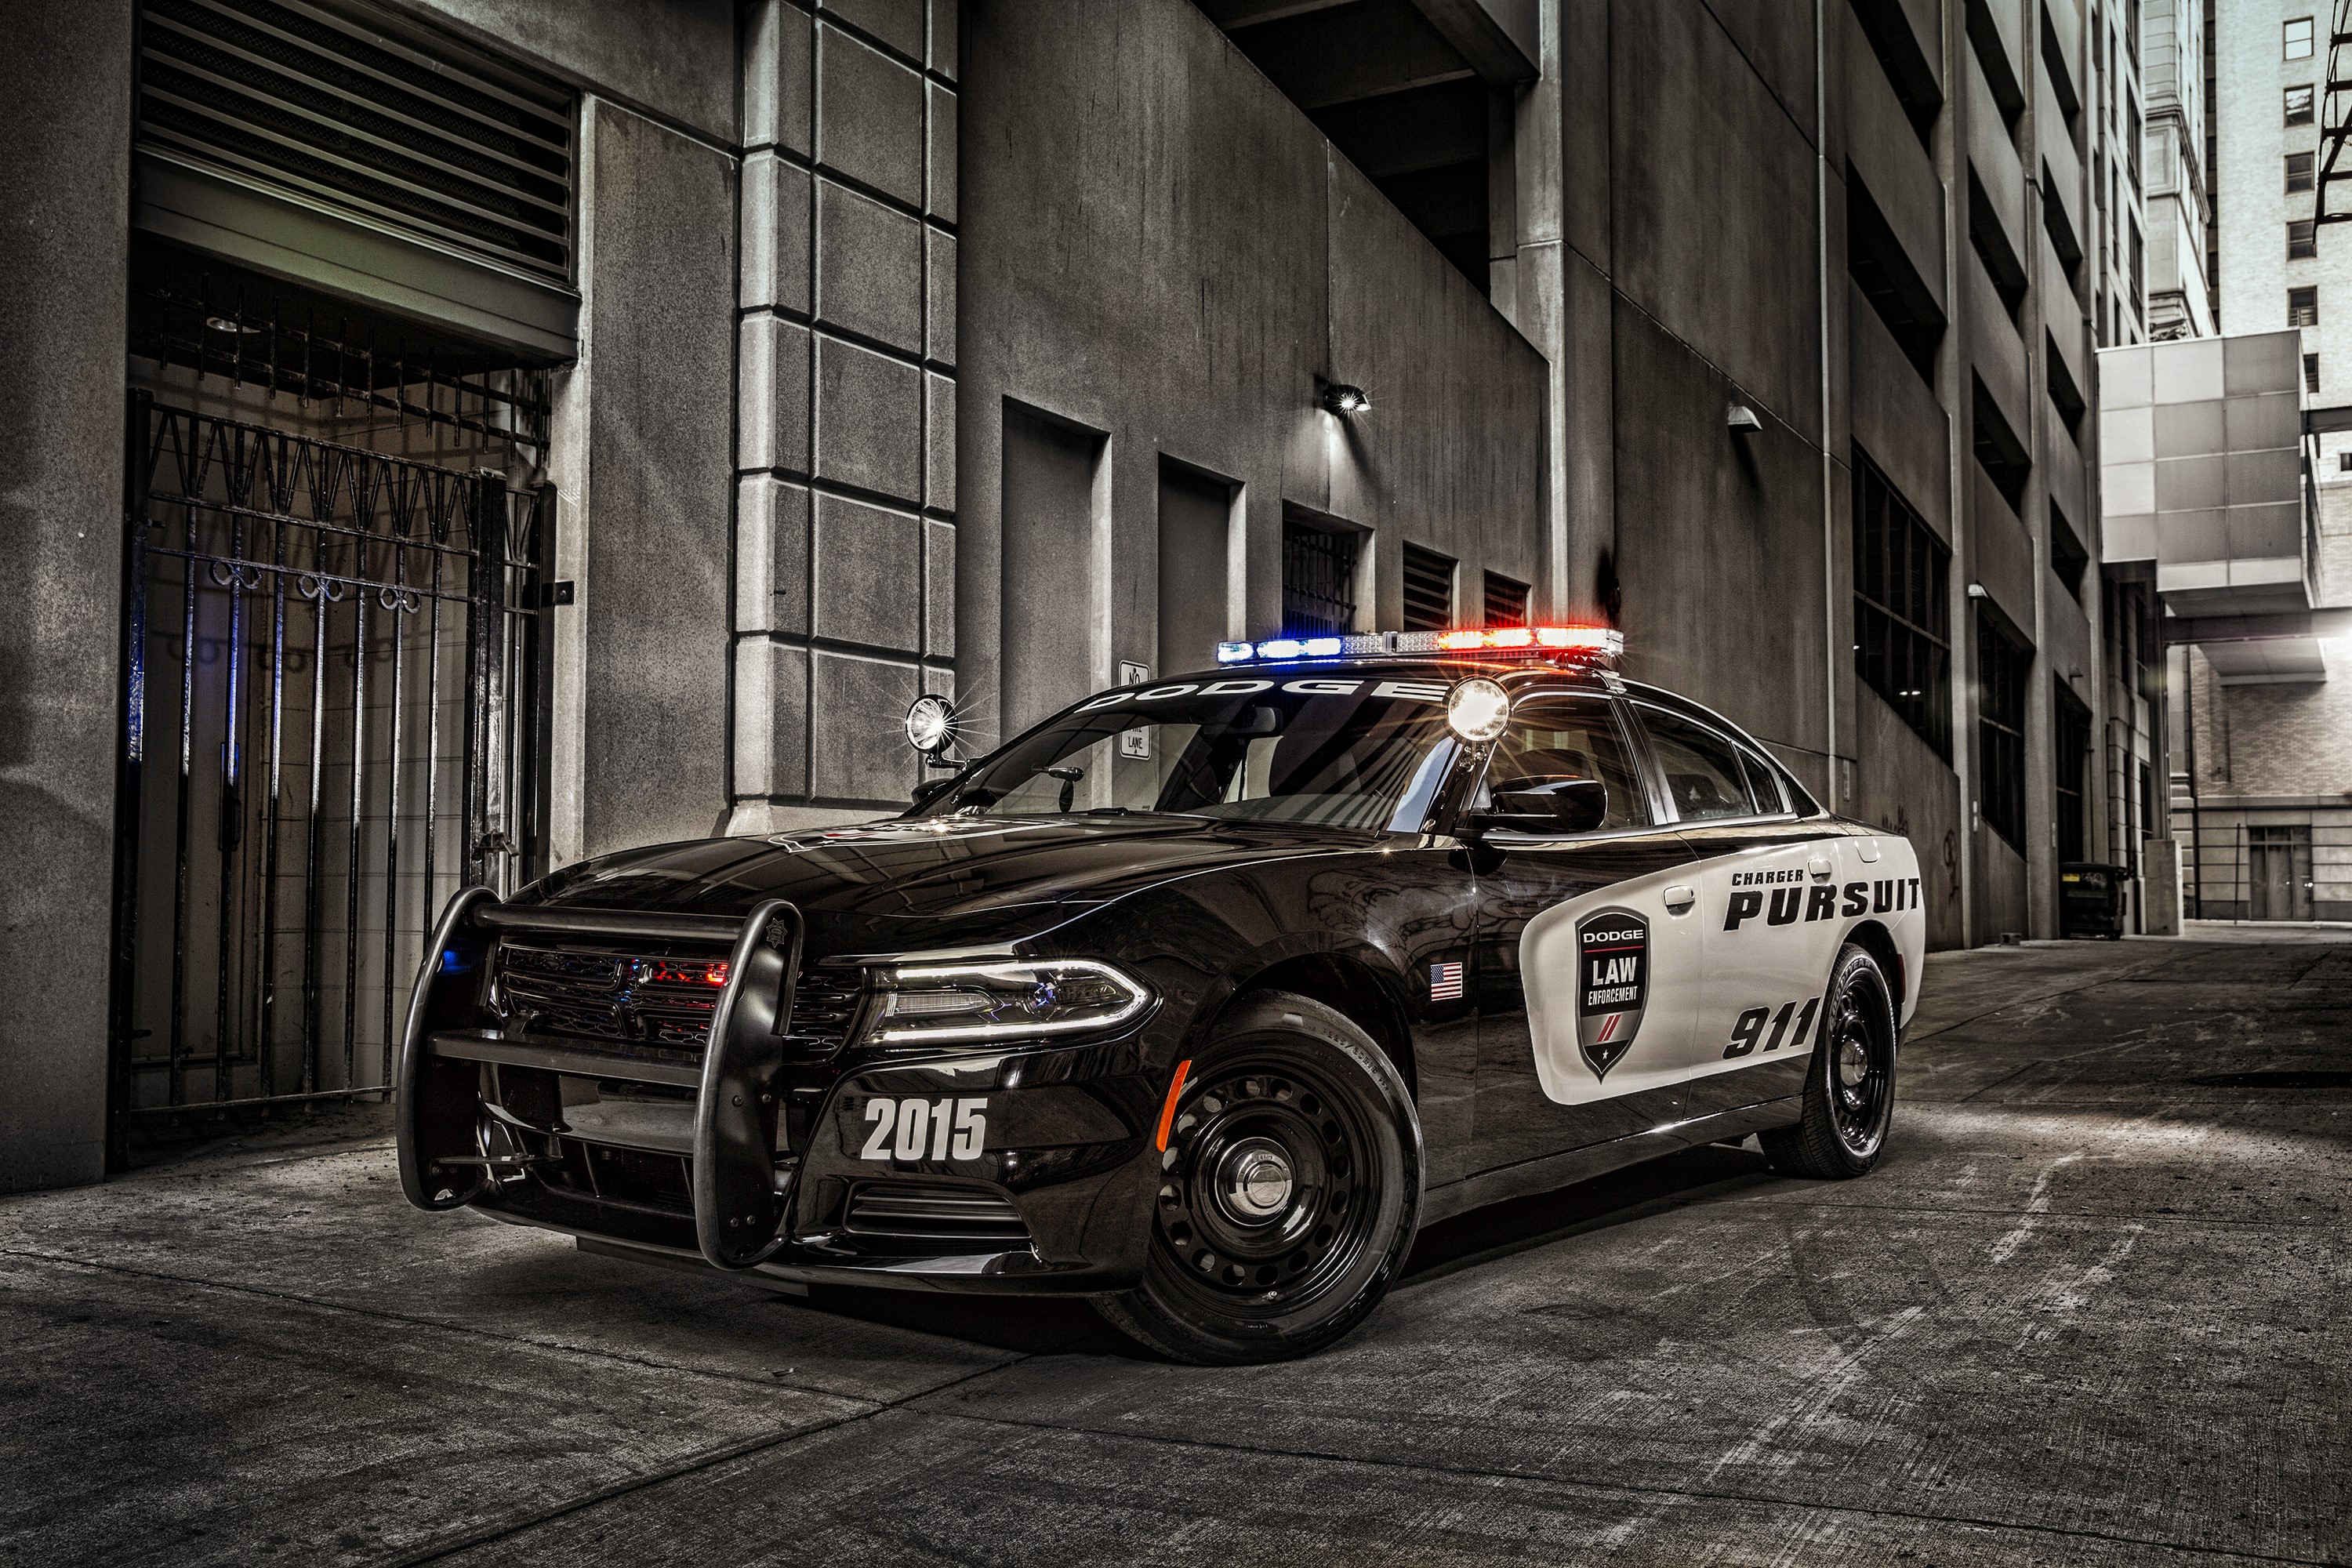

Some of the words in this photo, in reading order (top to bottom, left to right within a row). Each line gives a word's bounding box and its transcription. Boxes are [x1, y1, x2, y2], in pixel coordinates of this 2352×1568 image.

[1129, 673, 1140, 685] NO
[1073, 680, 1450, 713] DODGE
[1128, 735, 1142, 749] LANE
[1731, 869, 1803, 886] CHARGER
[1722, 877, 1919, 932] PURSUIT
[1583, 929, 1644, 943] DODGE
[1592, 956, 1637, 985] LAW
[1588, 985, 1638, 1006] ENFORCEMENT
[1828, 957, 1871, 1033] GOODYEAR
[1722, 996, 1821, 1059] 911
[861, 1098, 988, 1161] 2015
